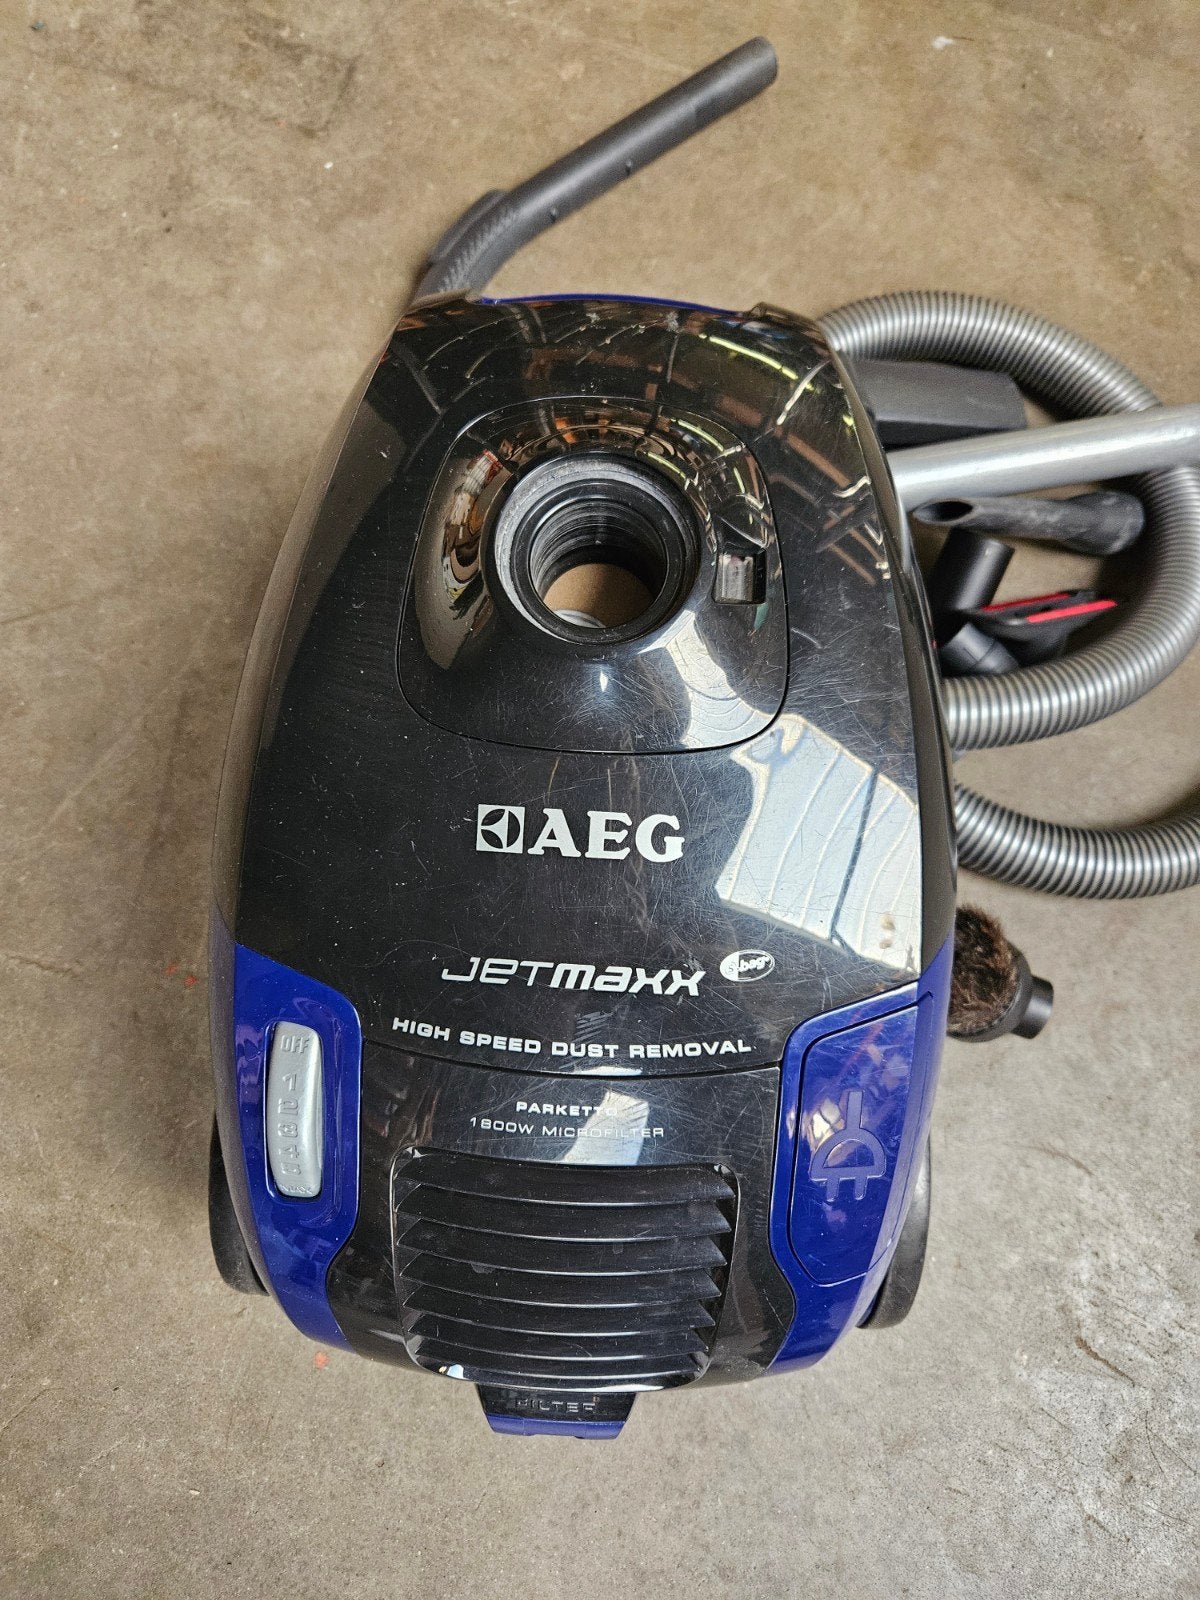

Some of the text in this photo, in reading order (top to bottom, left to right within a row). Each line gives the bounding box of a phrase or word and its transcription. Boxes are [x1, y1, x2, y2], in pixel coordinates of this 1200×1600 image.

[527, 808, 686, 862] AEG
[280, 1034, 310, 1054] OFF
[391, 1016, 752, 1060] HIGH SPEED DUST REMOVAL
[282, 1073, 298, 1092] 1
[516, 1101, 618, 1117] PARKETTO
[470, 1117, 665, 1138] 1800W MICROFILTER
